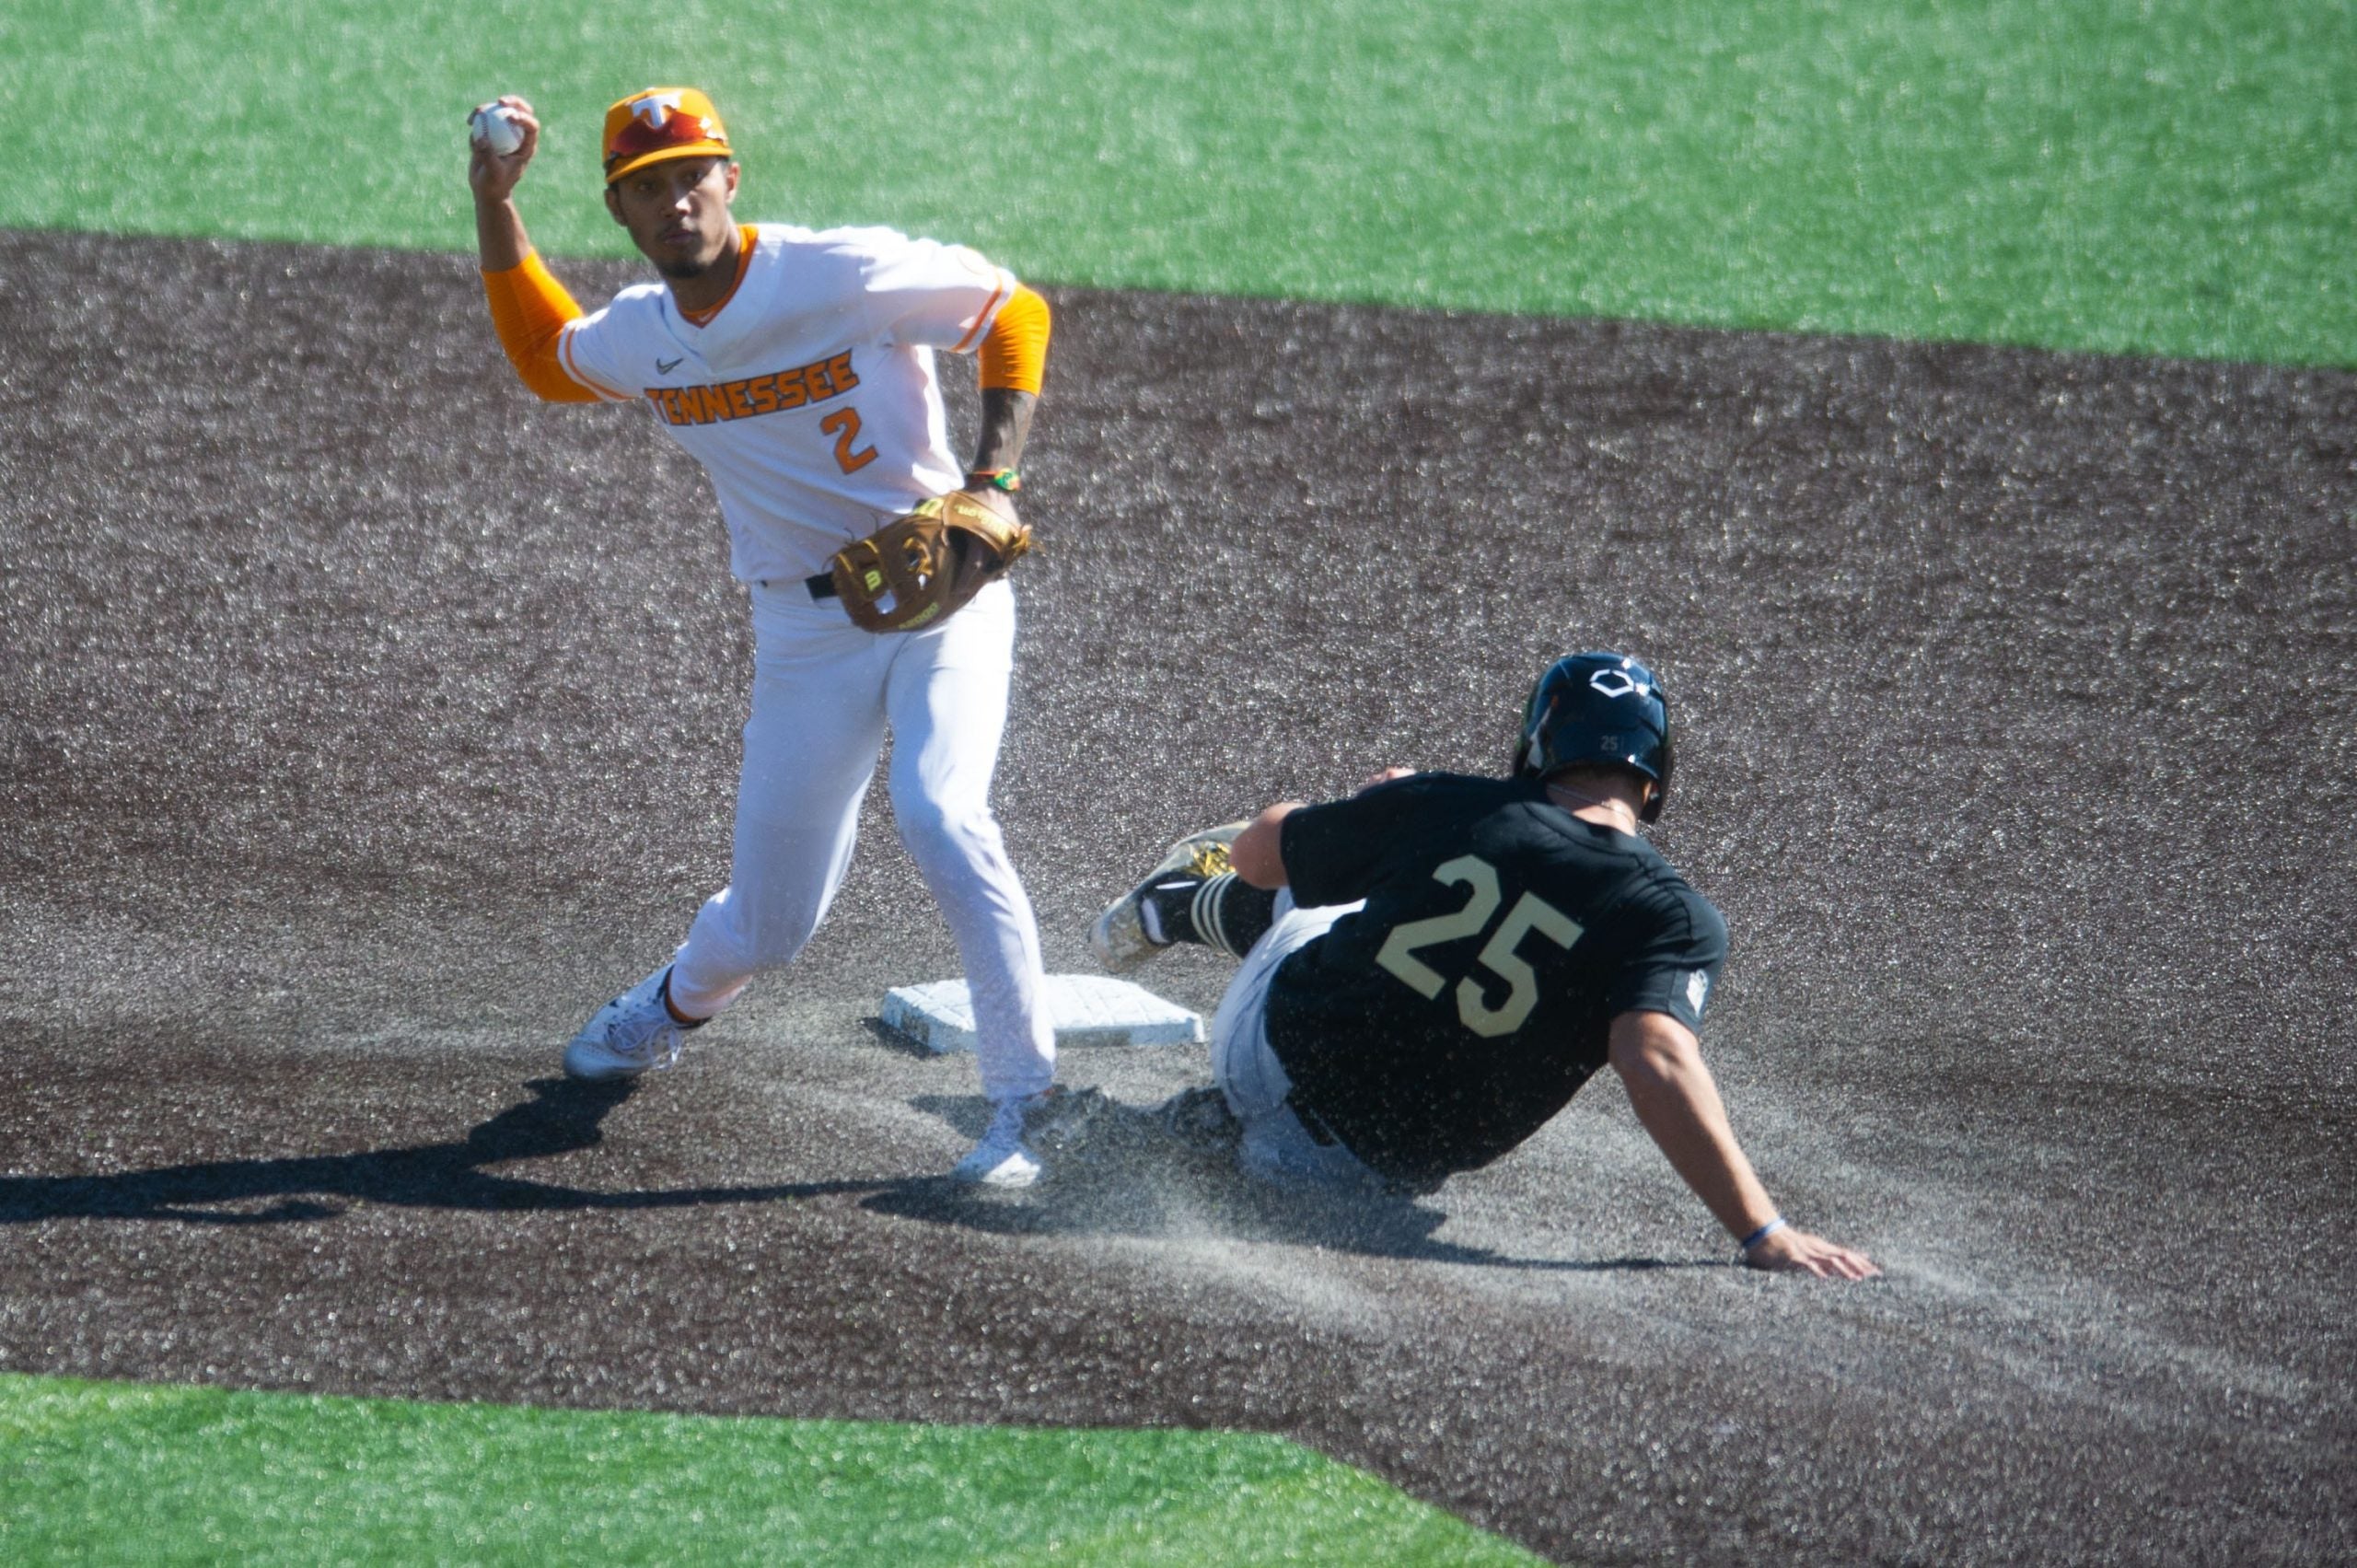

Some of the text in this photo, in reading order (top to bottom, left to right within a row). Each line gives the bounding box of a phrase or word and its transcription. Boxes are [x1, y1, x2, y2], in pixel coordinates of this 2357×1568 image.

[644, 348, 860, 426] TENNESSEE
[819, 407, 878, 475] 2
[1600, 736, 1619, 751] 25
[1375, 854, 1585, 1038] 25
